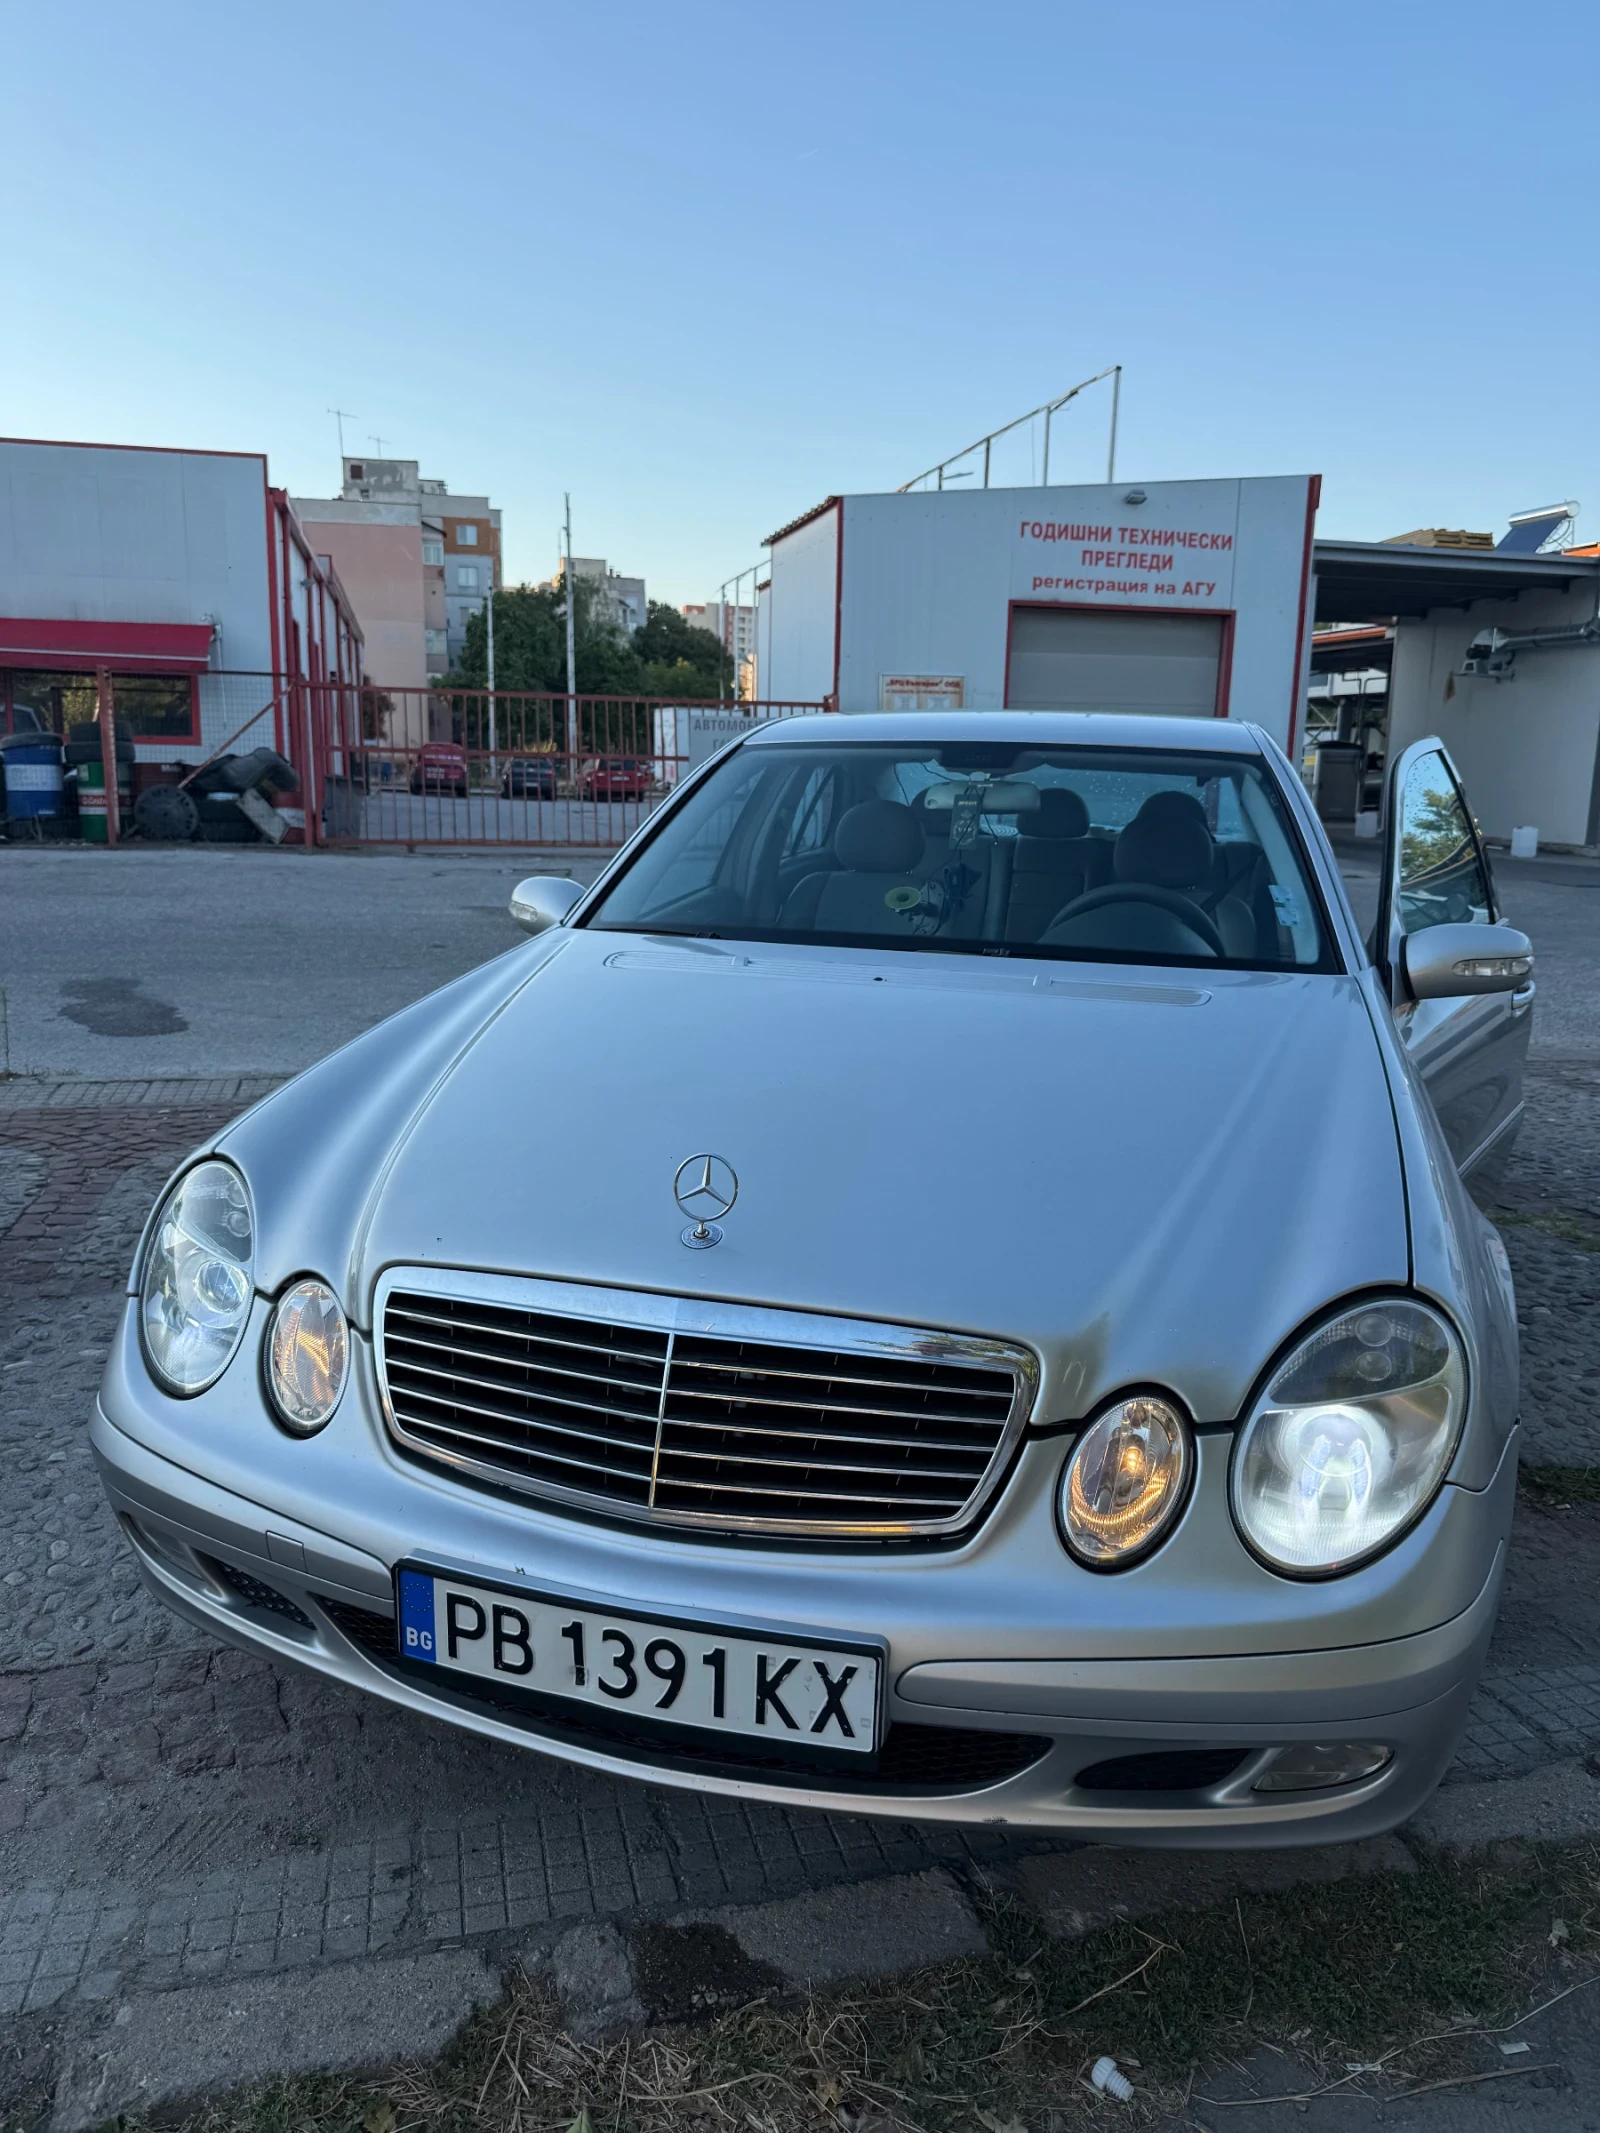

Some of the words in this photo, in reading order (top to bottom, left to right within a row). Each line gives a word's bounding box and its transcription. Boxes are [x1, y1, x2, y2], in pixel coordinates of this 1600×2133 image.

[1020, 521, 1112, 543] ГОДИШНИ
[1118, 527, 1233, 551] ТЕХНИЧЕСКИ
[1081, 549, 1174, 573] ПРЕГЛЕДИ
[1032, 575, 1149, 595] регистрация
[1154, 583, 1176, 595] на
[1182, 581, 1217, 596] АГУ
[405, 1626, 433, 1651] BG
[446, 1591, 535, 1675] PB
[561, 1620, 727, 1720] 1391
[755, 1653, 858, 1738] KX
